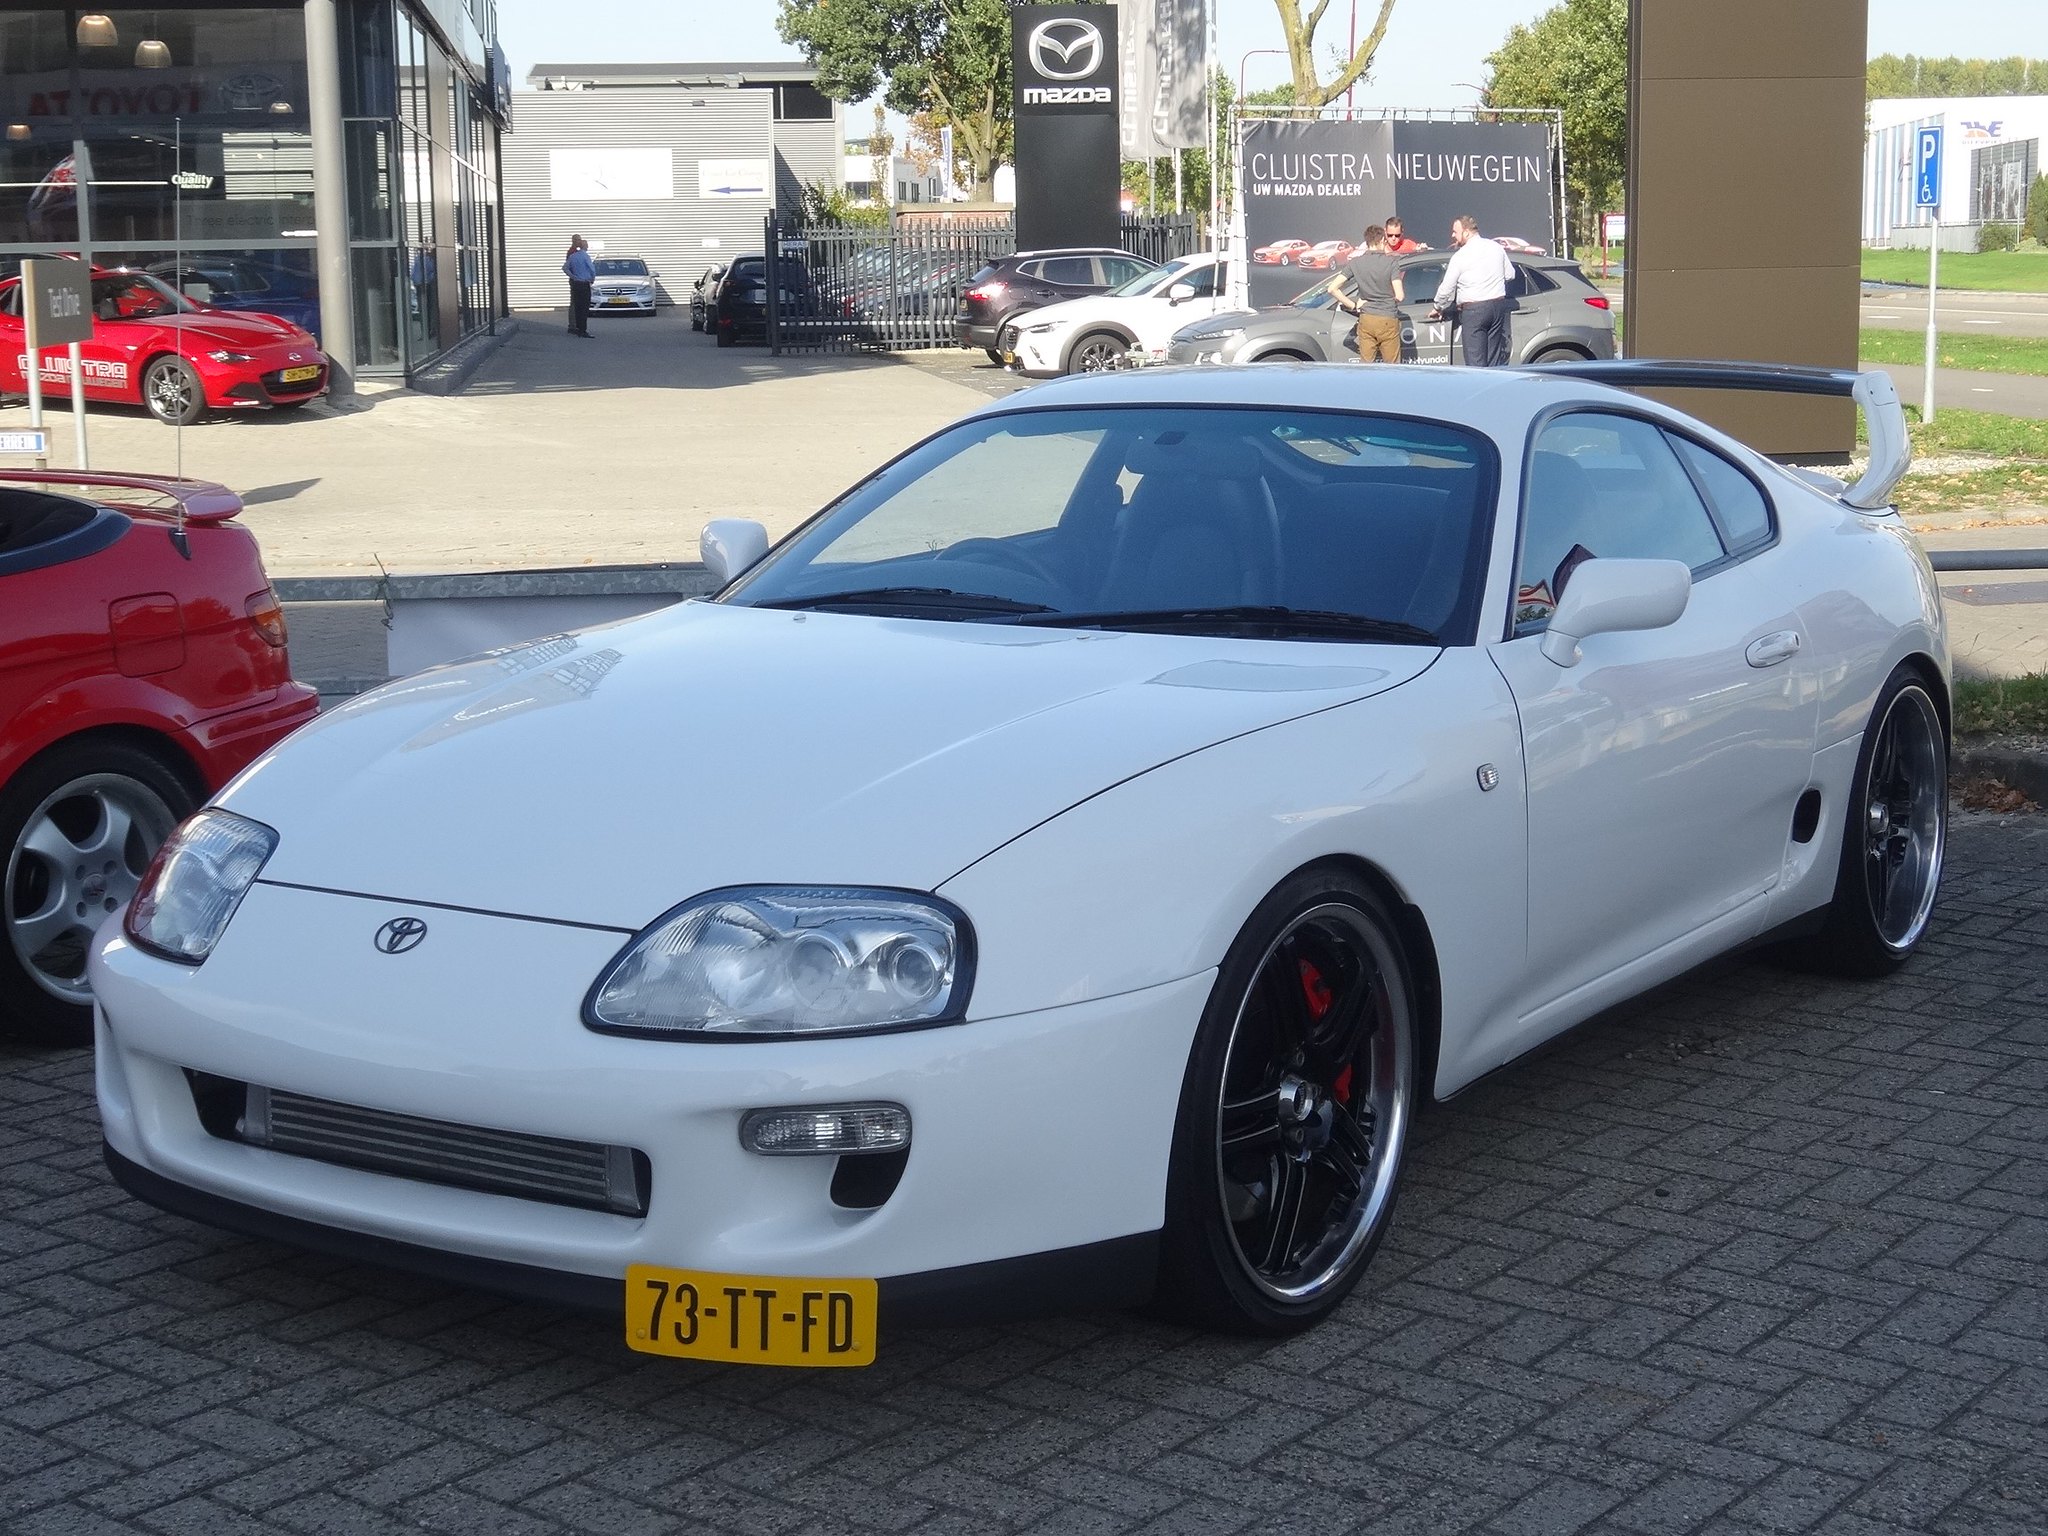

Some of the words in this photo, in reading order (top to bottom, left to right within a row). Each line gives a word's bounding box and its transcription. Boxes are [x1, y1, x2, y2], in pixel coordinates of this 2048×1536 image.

[1023, 87, 1112, 104] mazda
[1922, 134, 1936, 174] P
[1252, 153, 1375, 181] CLUISTRA
[1386, 153, 1541, 183] NIEUWEGEIN
[171, 174, 214, 188] Quality
[1253, 184, 1272, 196] UW
[1274, 184, 1314, 196] MAZDA
[1318, 184, 1362, 196] DEALER
[17, 354, 128, 379] CUISTRA
[1413, 355, 1449, 364] Hyundai
[646, 1279, 854, 1353] 73-TT-FD
